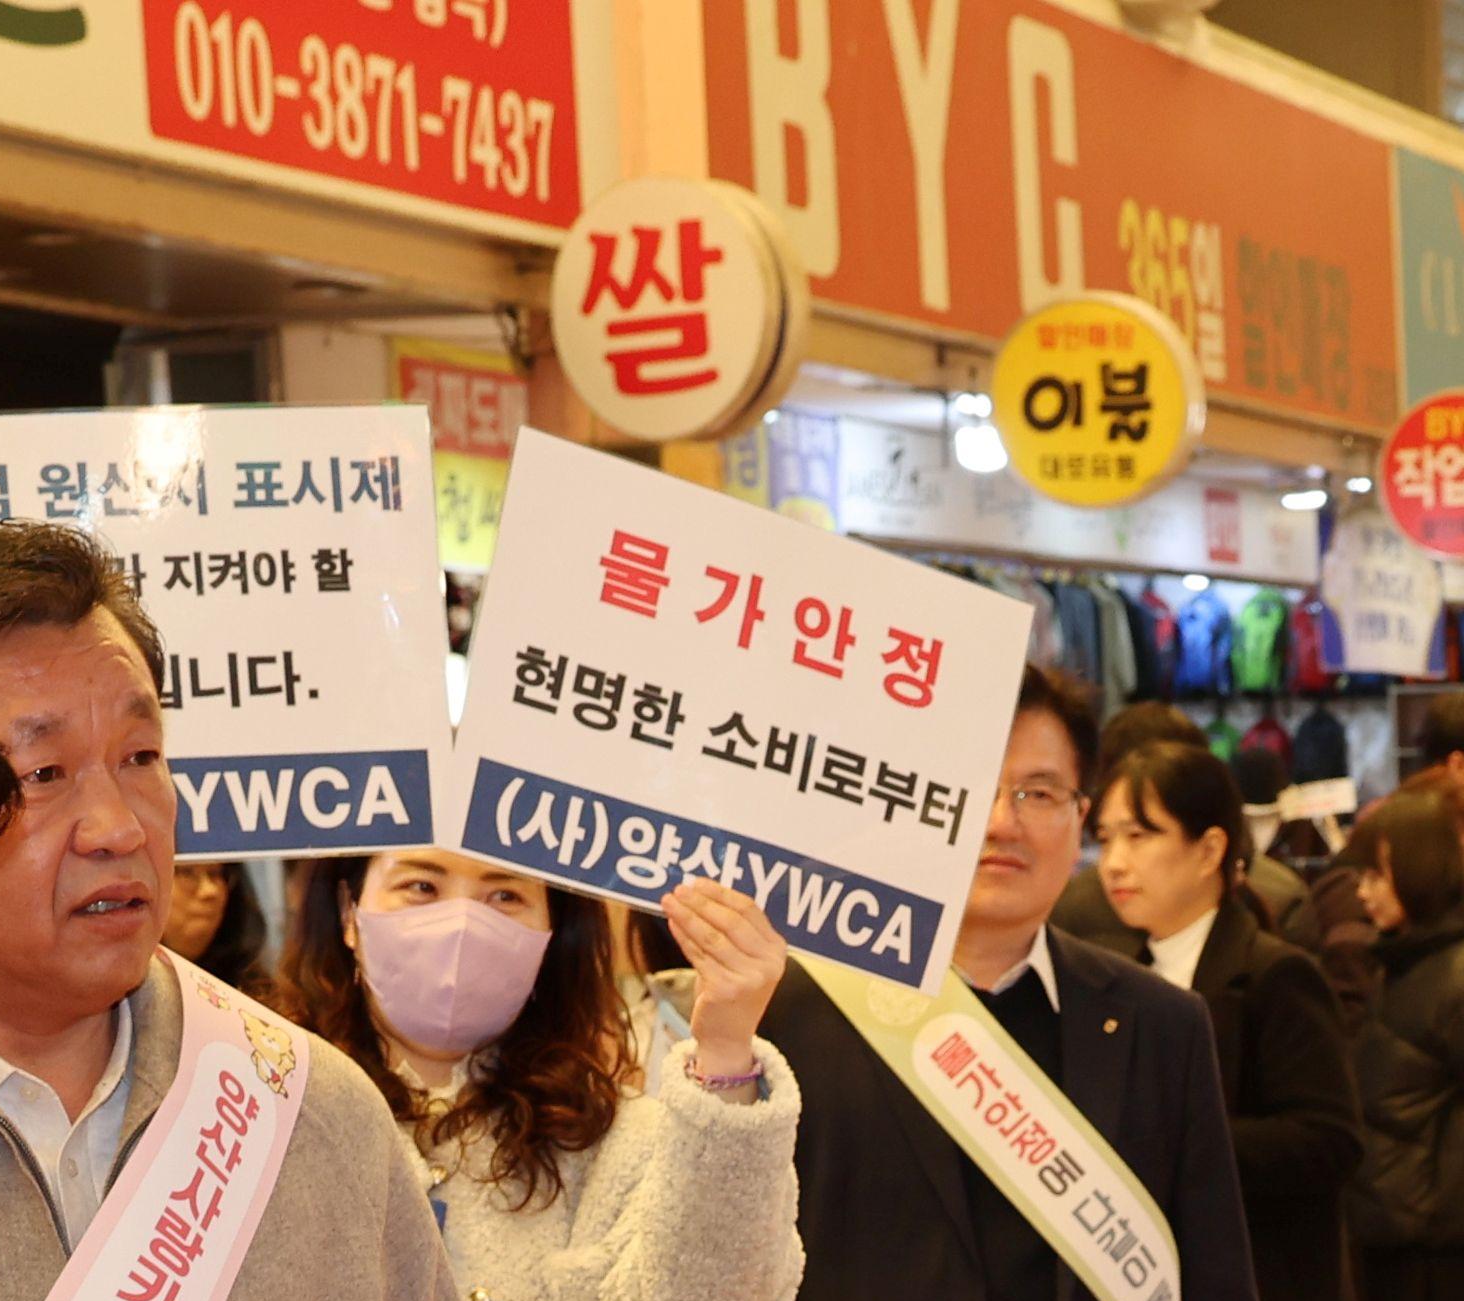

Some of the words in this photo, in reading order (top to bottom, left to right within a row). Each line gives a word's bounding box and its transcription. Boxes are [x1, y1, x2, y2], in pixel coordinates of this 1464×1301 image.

[174, 1, 555, 203] 010-3871-7437
[745, 0, 1085, 315] BYC
[579, 216, 725, 398] 쌀
[233, 456, 403, 512] 표시제
[1022, 361, 1152, 443] 이불
[163, 549, 297, 595] 지켜야
[311, 546, 353, 592] 할
[598, 529, 945, 710] 물가안정
[512, 644, 687, 751] 현명한
[700, 709, 970, 846] 소비로부터
[495, 777, 917, 965] (사)양산YWCA
[929, 1031, 1086, 1198] 물가안정에
